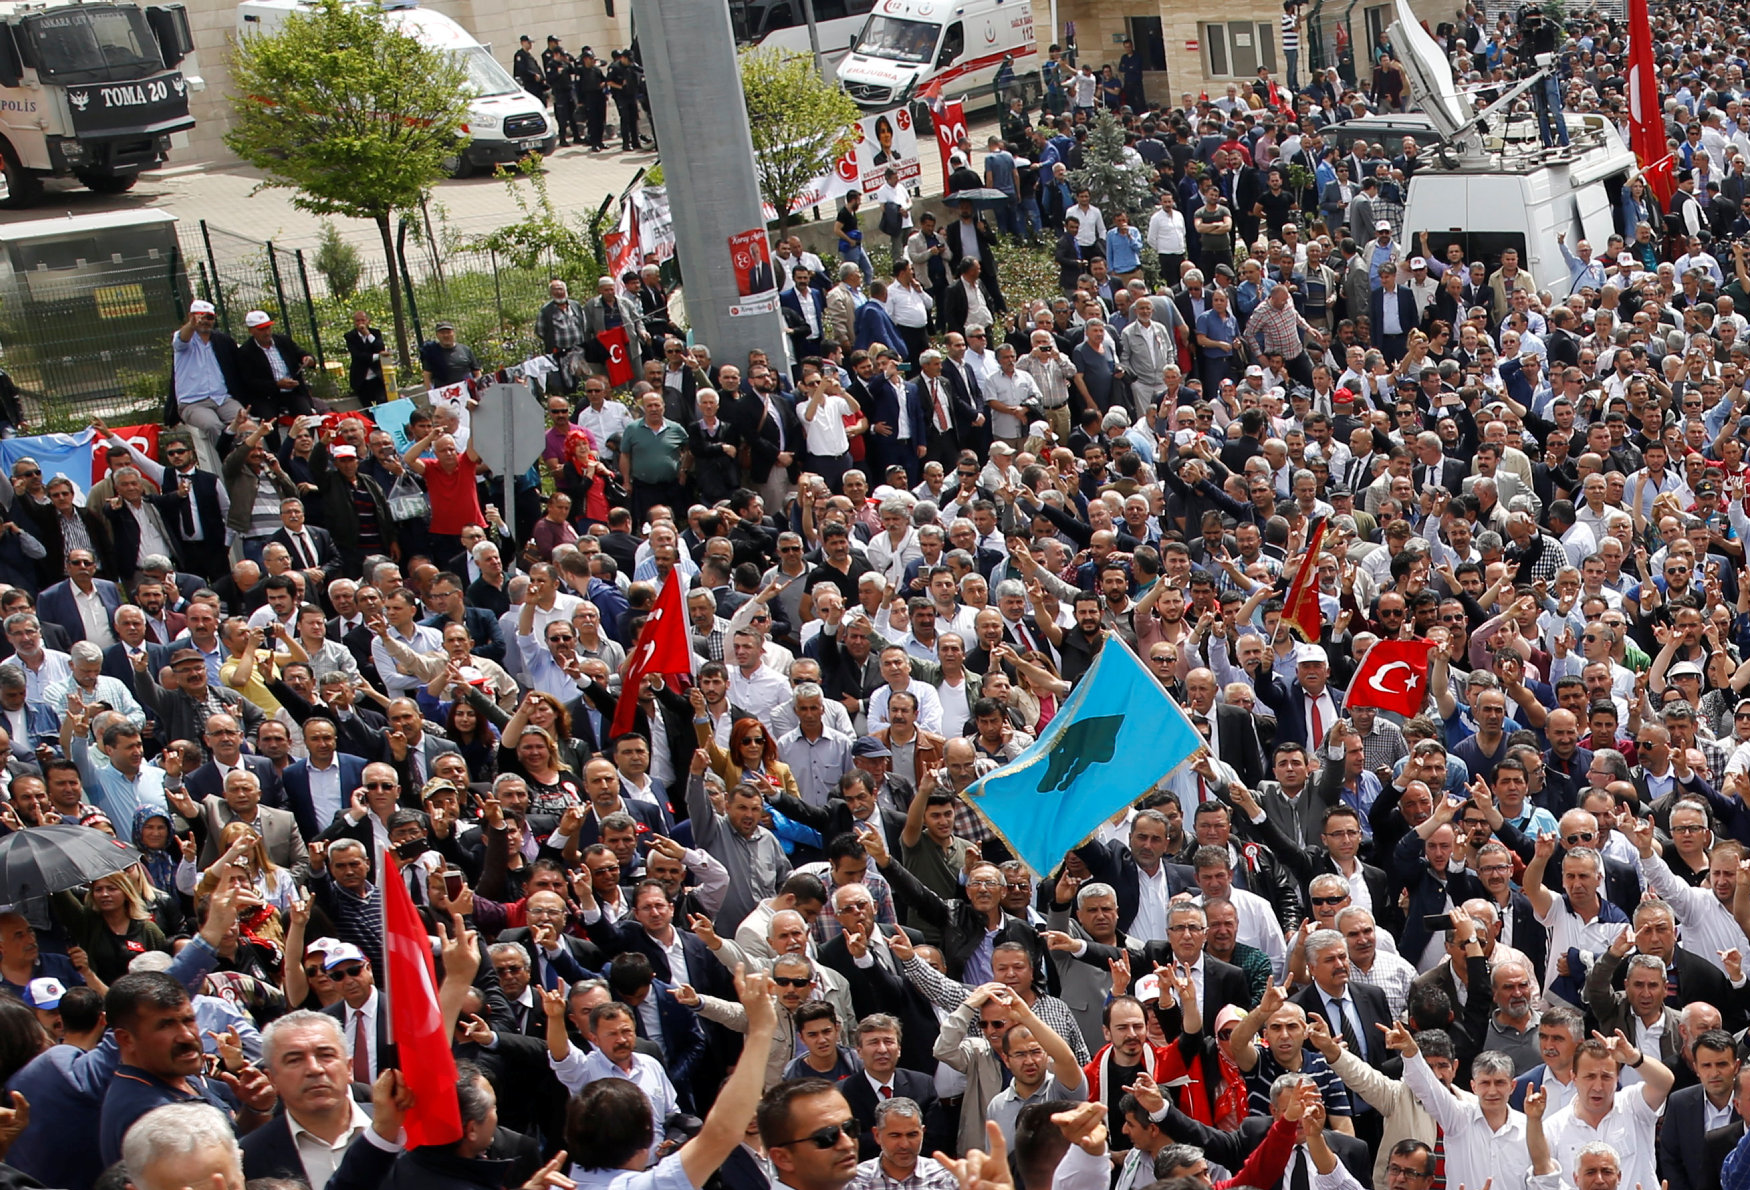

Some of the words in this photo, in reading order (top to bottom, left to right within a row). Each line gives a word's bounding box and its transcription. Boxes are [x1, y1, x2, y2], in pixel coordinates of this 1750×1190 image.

[41, 16, 71, 29] ANKARA
[1022, 25, 1034, 41] 112
[101, 84, 147, 108] TOMA
[148, 81, 168, 102] 20
[1, 99, 37, 113] POLİS
